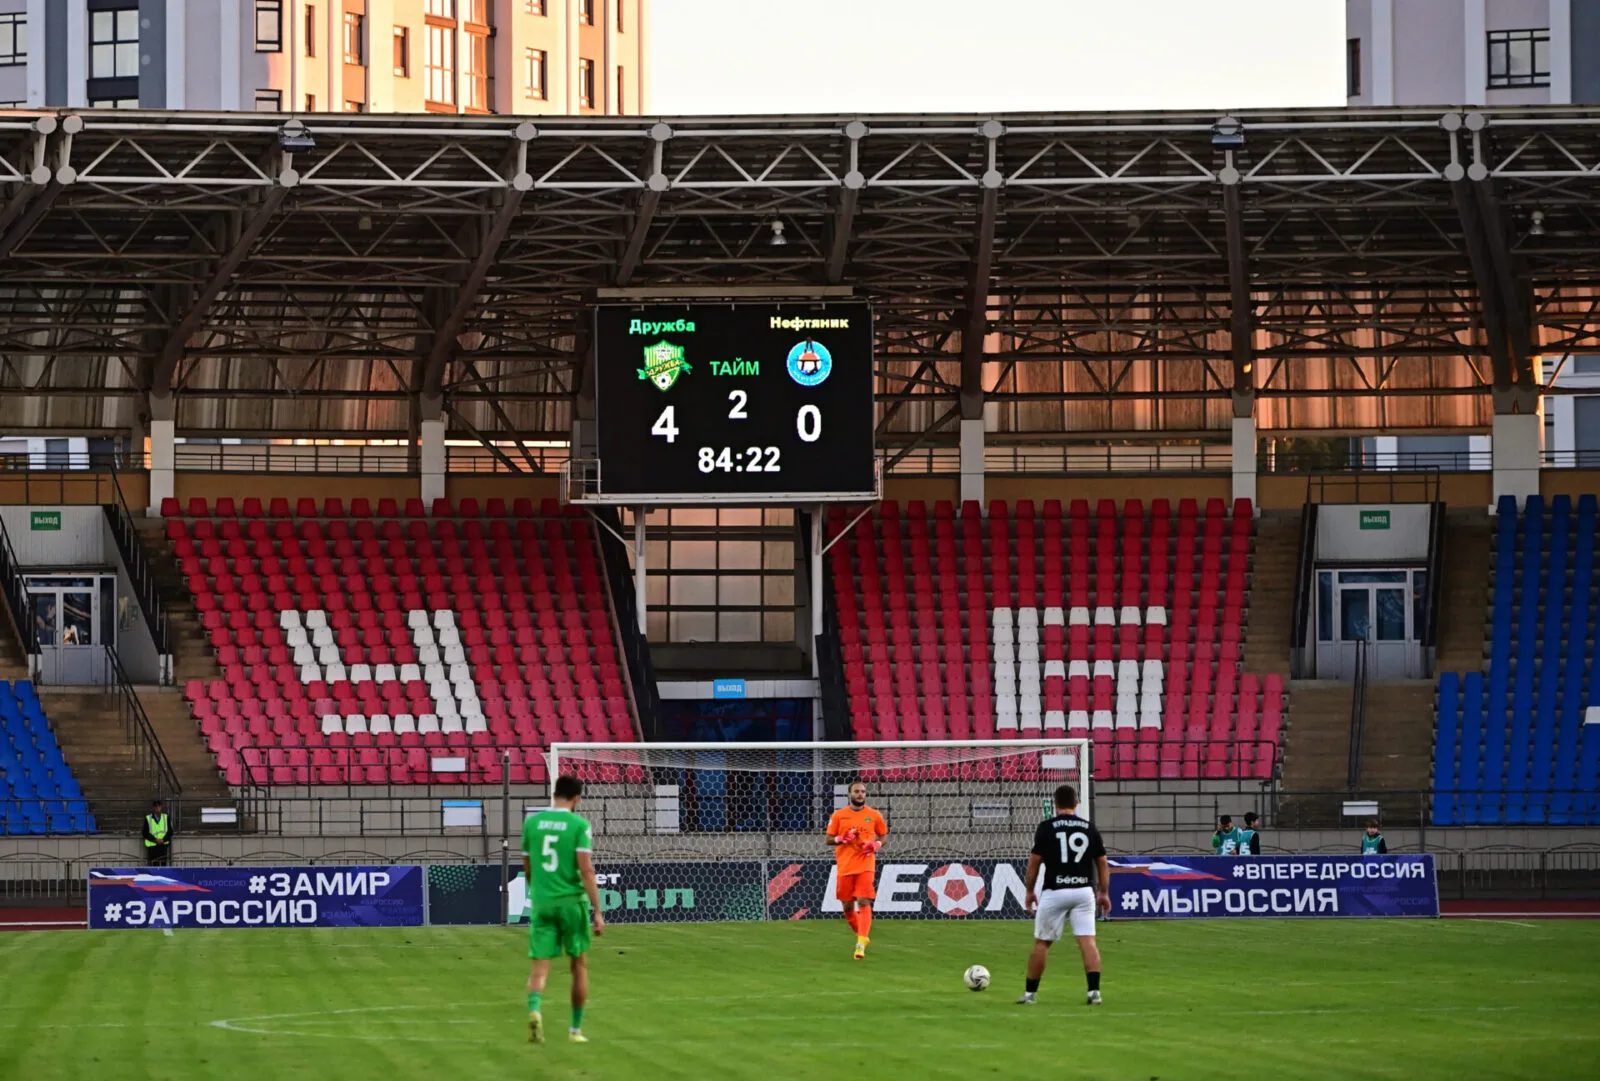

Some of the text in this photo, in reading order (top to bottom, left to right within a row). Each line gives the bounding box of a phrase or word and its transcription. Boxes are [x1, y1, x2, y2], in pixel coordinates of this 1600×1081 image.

[629, 319, 695, 336] Дружба
[769, 316, 850, 332] Нефтяник
[709, 357, 760, 377] ТАЙМ
[728, 389, 748, 419] 2
[651, 405, 680, 443] 4
[796, 404, 822, 442] 0
[698, 446, 781, 473] 84:22
[34, 516, 59, 525] ВЫХОД
[1363, 515, 1388, 524] ВЫХОД
[717, 684, 742, 693] ВЫХОД
[541, 834, 560, 872] 5
[1055, 831, 1089, 864] 19
[249, 871, 391, 896] #ЗАМИР
[596, 873, 621, 885] ет
[1232, 862, 1425, 881] #ВПЕРЕДРОССИЯ
[104, 898, 317, 925] #ЗАРОССИЮ
[1121, 888, 1339, 914] #МЫРОССИЯ
